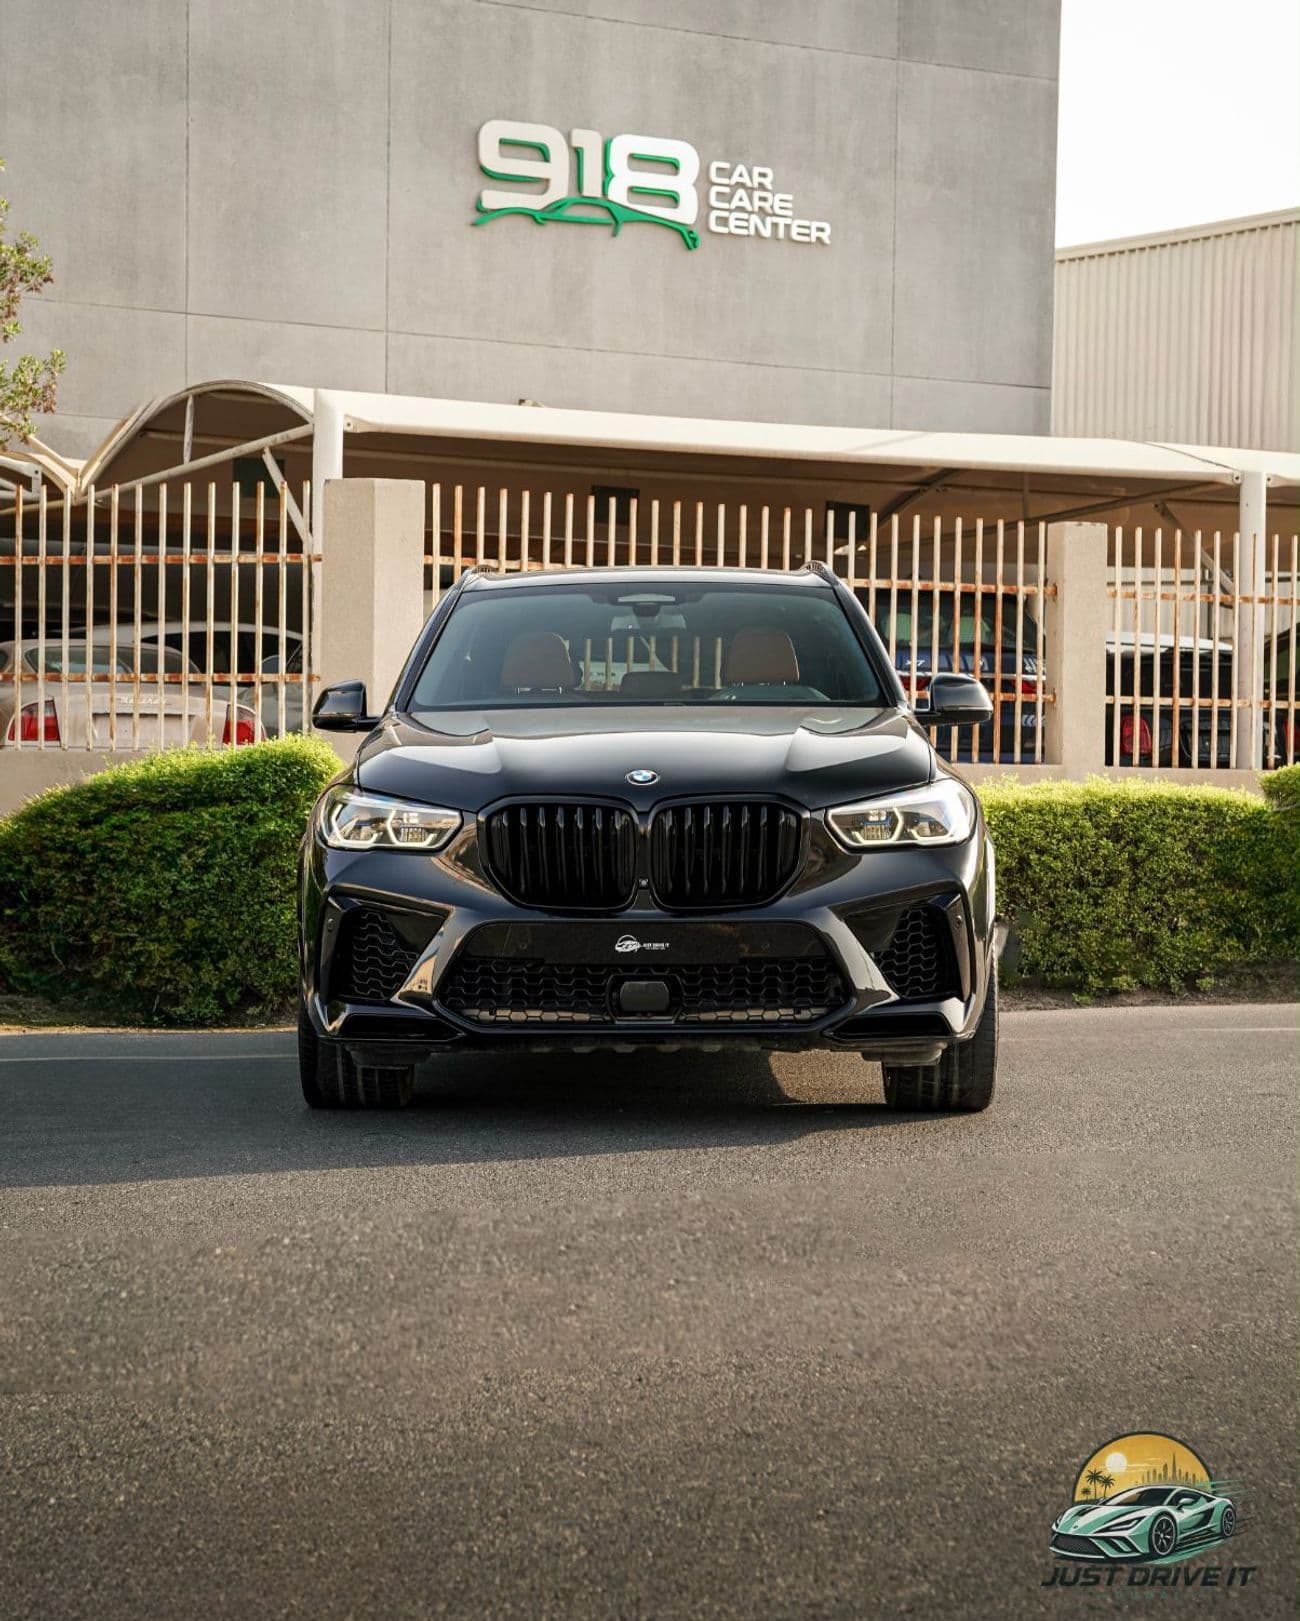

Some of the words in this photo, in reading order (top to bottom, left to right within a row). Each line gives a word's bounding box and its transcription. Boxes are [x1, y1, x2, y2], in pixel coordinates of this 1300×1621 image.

[478, 119, 701, 226] 918
[709, 160, 774, 191] CAR
[708, 184, 794, 217] CARE
[708, 208, 831, 245] CENTER
